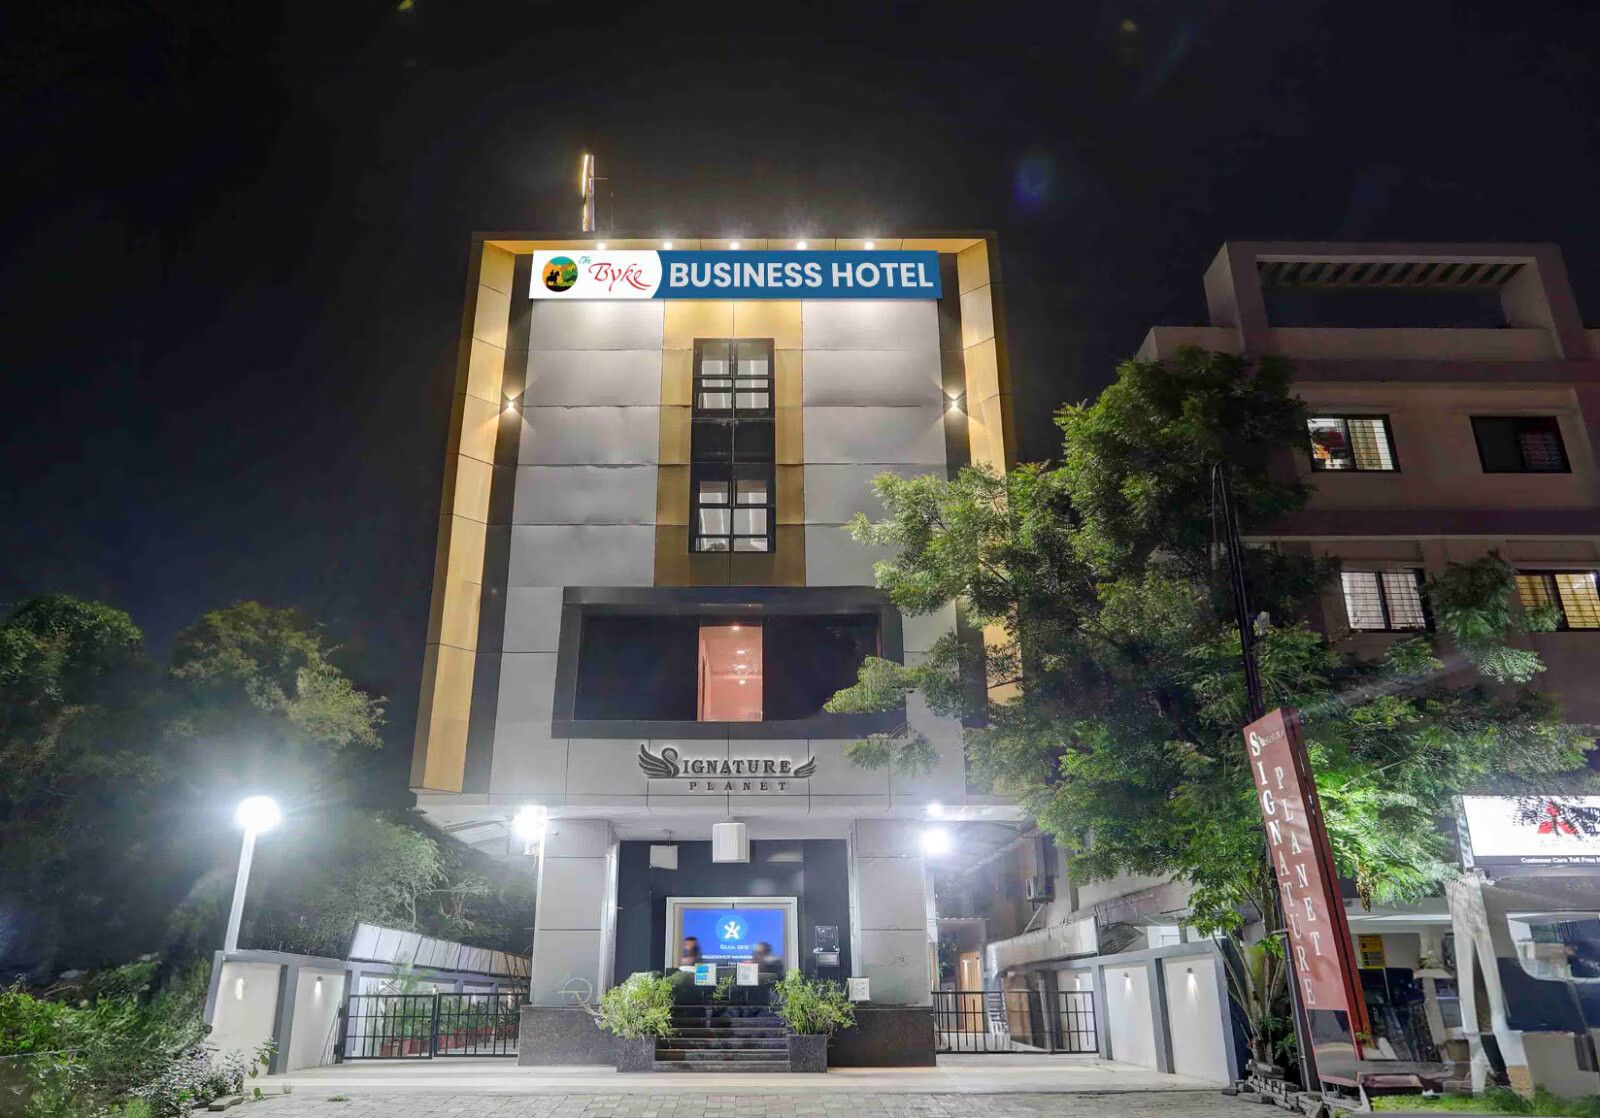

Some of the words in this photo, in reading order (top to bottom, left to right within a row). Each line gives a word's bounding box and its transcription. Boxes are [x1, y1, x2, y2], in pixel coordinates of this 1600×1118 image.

[588, 262, 652, 292] Byke
[669, 261, 822, 288] BUSINESS
[832, 261, 934, 288] HOTEL
[689, 781, 787, 791] PLANET
[1249, 730, 1316, 1005] SIGNATURE
[1274, 766, 1321, 956] PLANET
